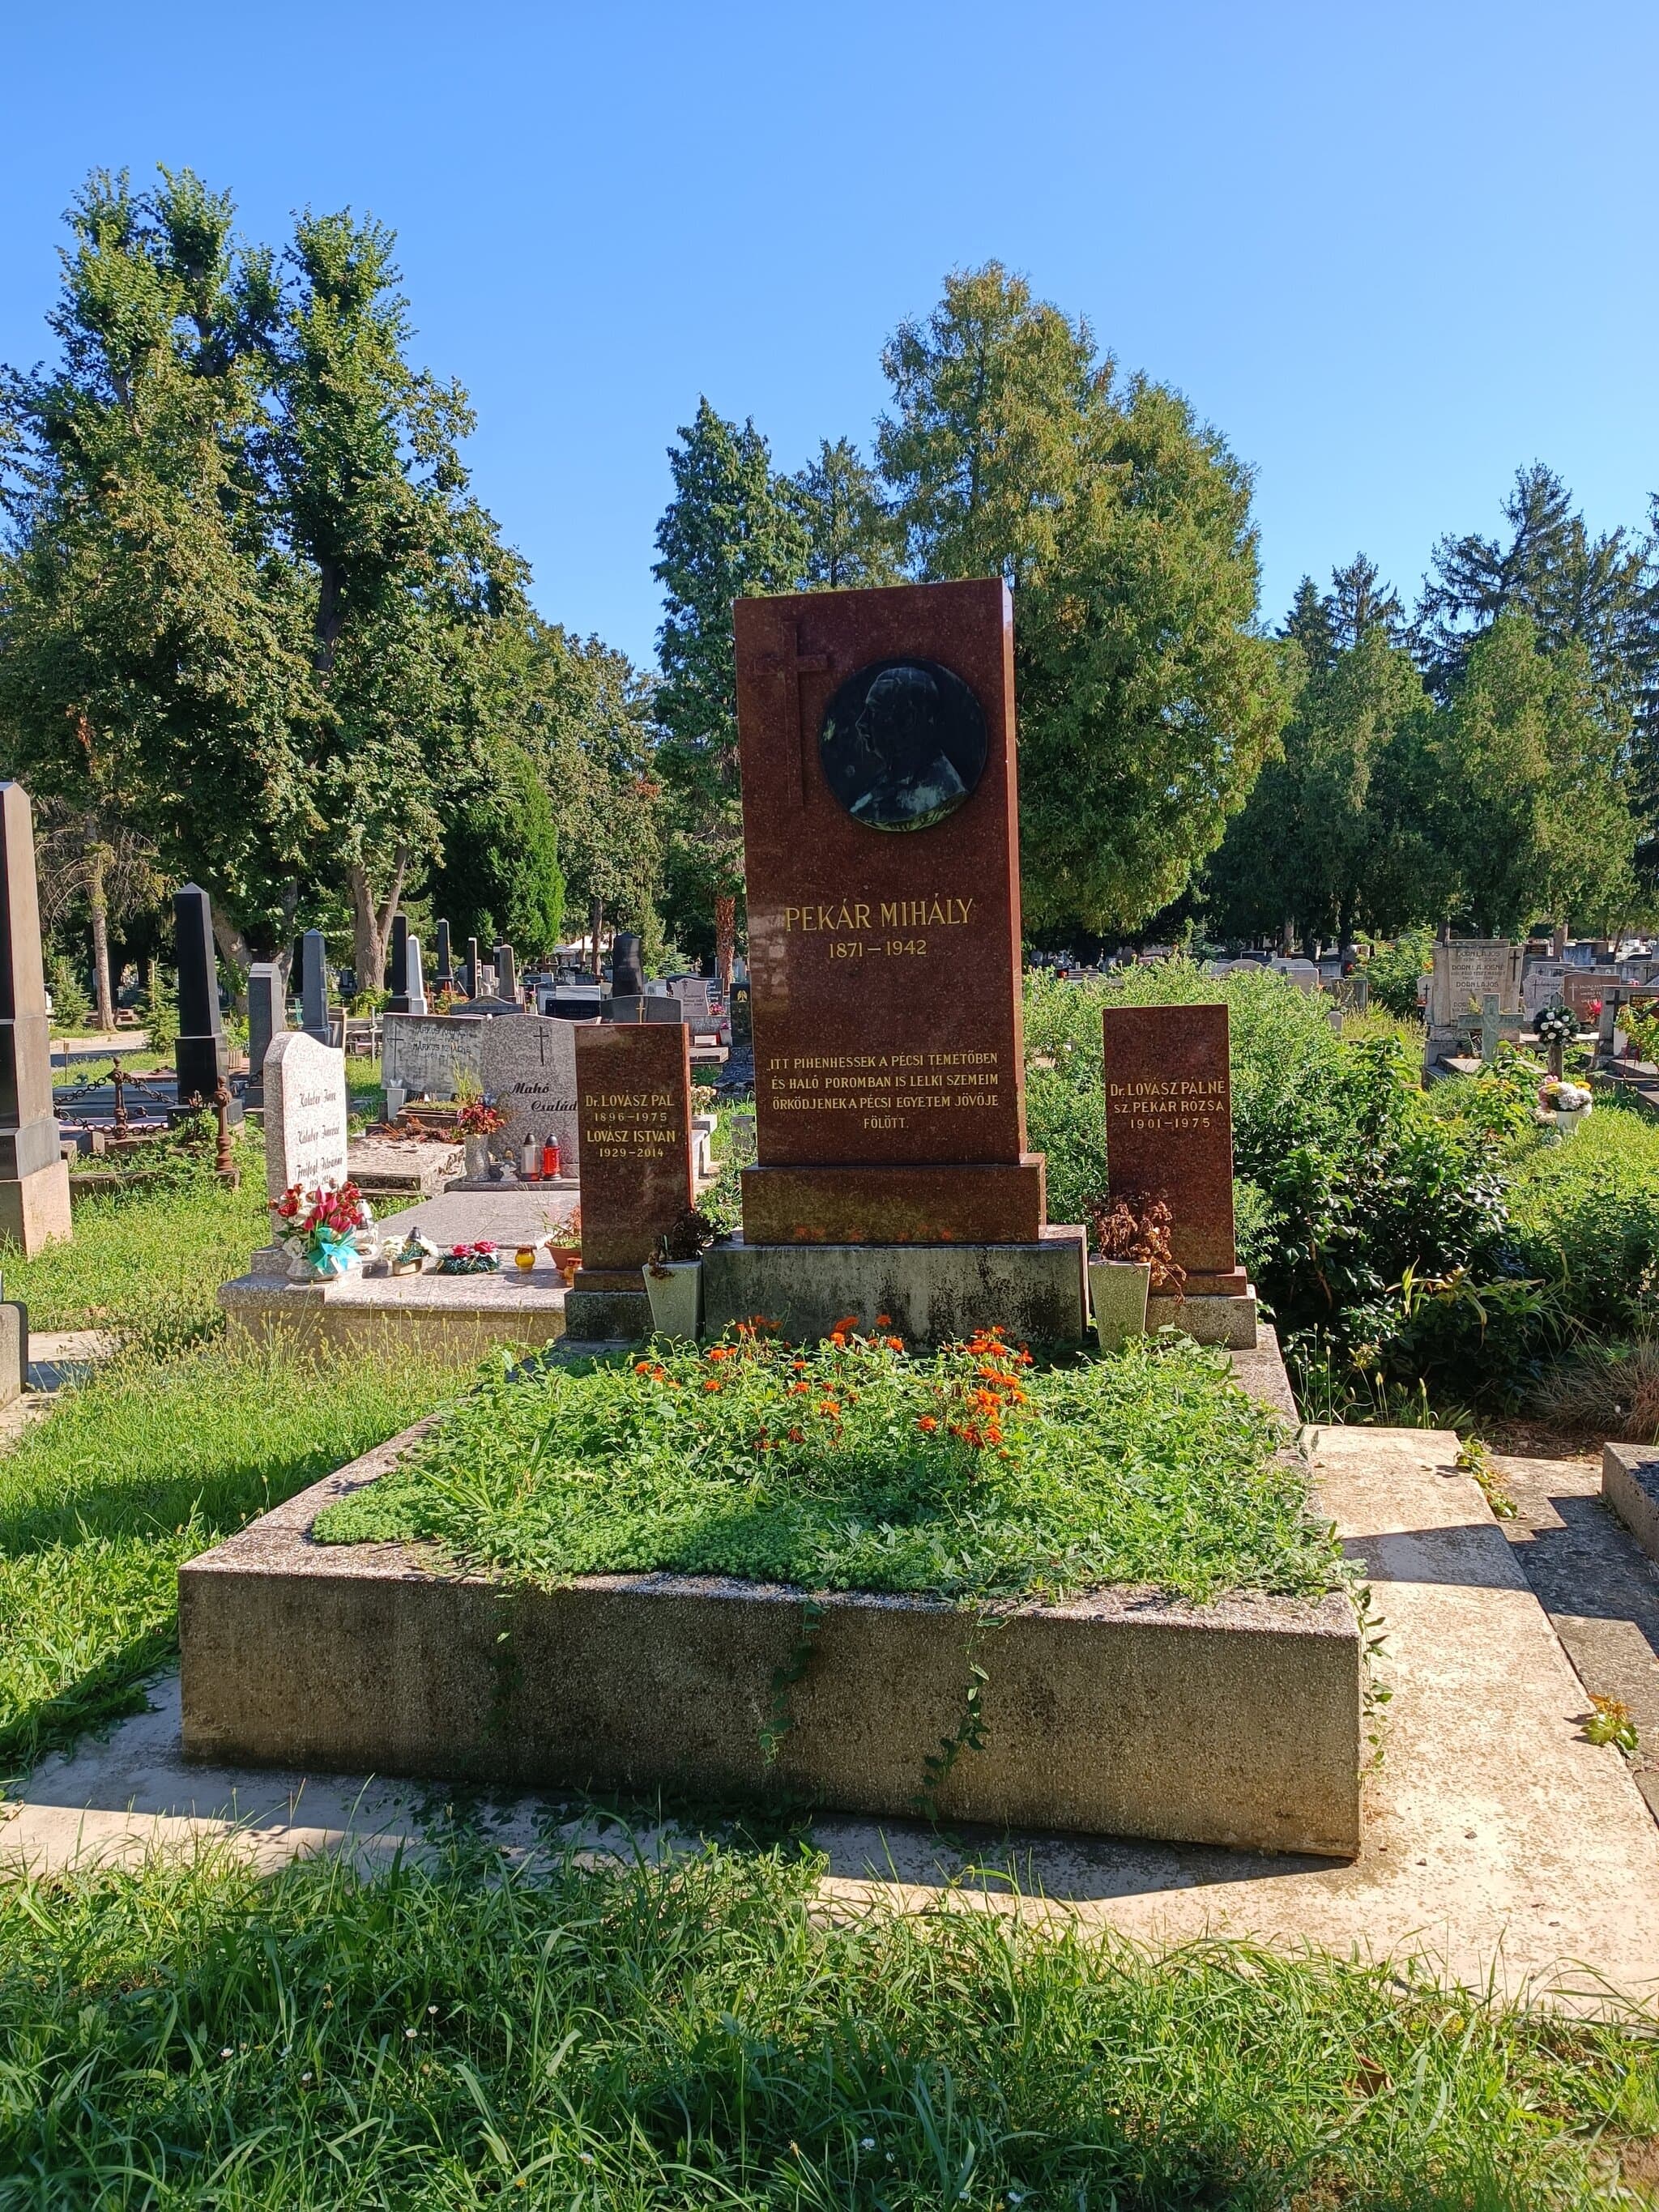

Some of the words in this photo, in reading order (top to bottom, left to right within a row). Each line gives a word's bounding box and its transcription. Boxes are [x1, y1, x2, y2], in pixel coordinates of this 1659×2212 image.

[784, 898, 872, 931] PEKÁR
[881, 893, 973, 927] MIHÁLY
[794, 1056, 876, 1068] PIHENHESSEK
[879, 1056, 888, 1067] A
[891, 1052, 923, 1066] PÉCSI
[928, 1050, 998, 1065] TEMETŐBEN
[510, 1082, 550, 1093] Mahó
[771, 1075, 786, 1089] ÉS
[789, 1074, 819, 1089] HALÓ
[825, 1076, 891, 1089] POROMBAN
[895, 1076, 906, 1087] IS
[910, 1075, 942, 1086] LELKI
[946, 1073, 998, 1085] SZEMEIM
[1181, 1076, 1226, 1094] PÁLNÉ
[531, 1100, 578, 1111] Család
[848, 1097, 857, 1109] A
[859, 1094, 891, 1109] PÉCSI
[896, 1096, 950, 1108] EGYETEM
[1181, 1096, 1225, 1112] RÓZSA
[587, 1126, 629, 1143] LOVÁSZ
[633, 1125, 676, 1143] ISTVÁN
